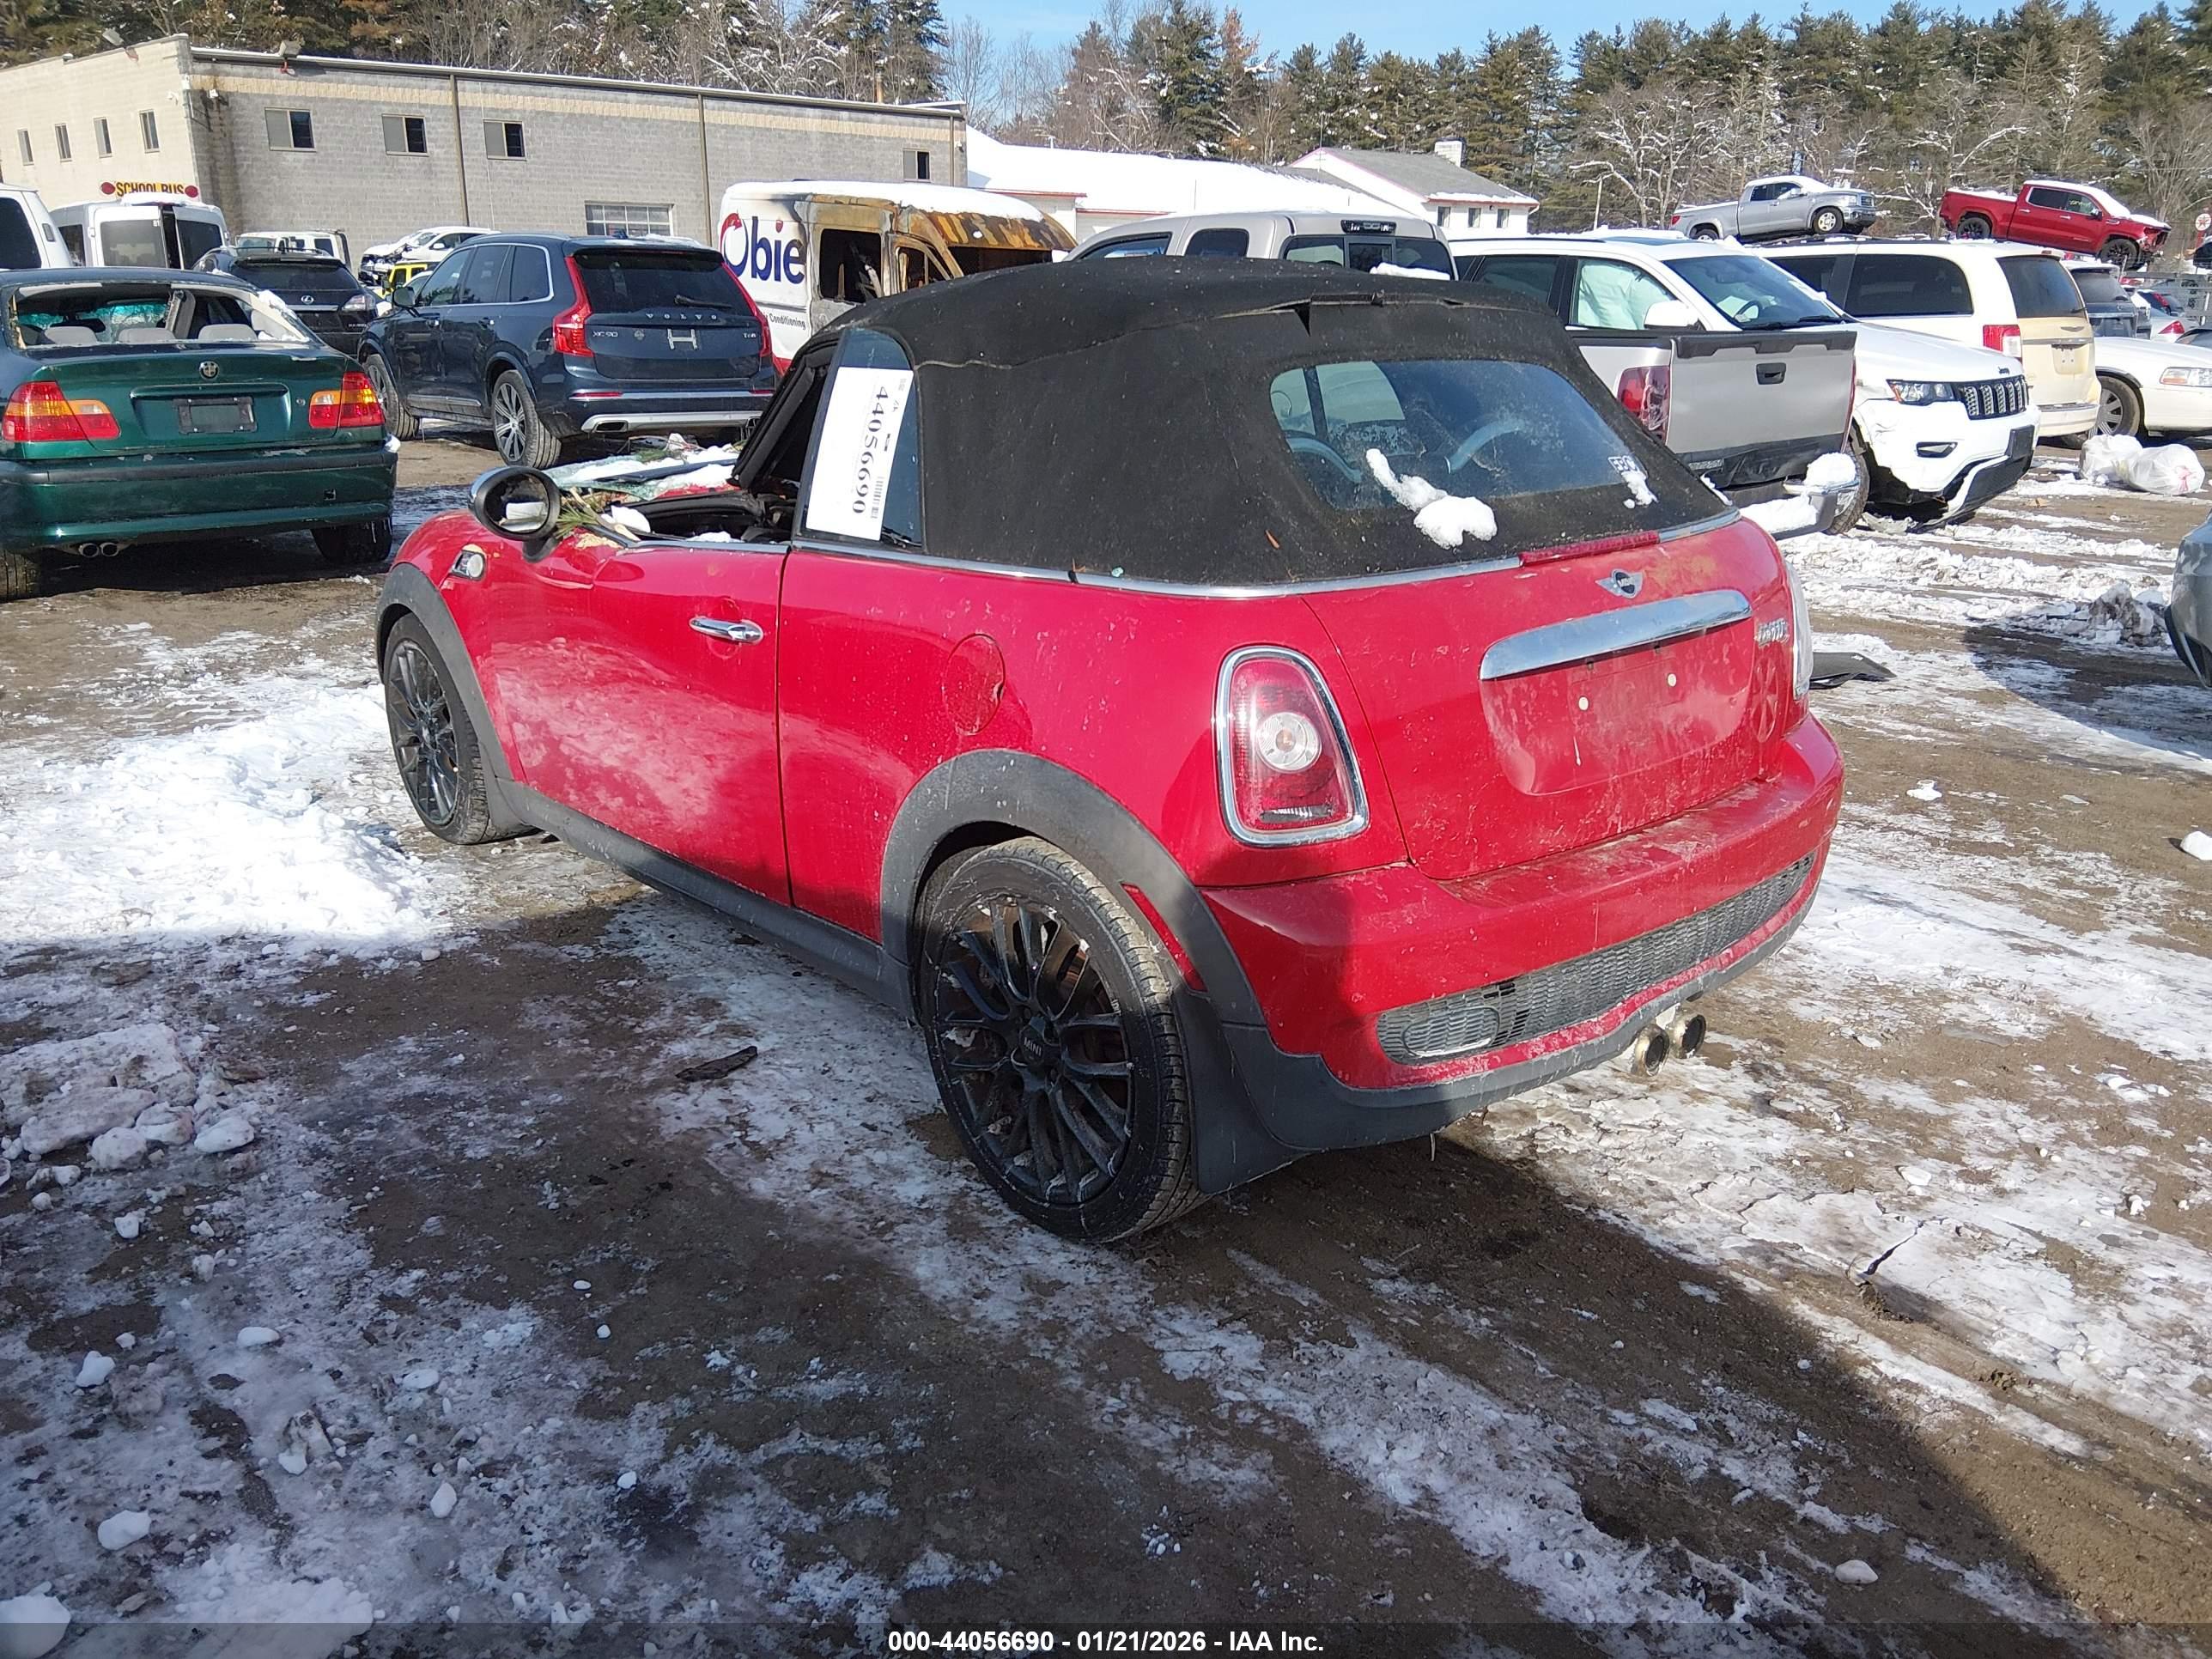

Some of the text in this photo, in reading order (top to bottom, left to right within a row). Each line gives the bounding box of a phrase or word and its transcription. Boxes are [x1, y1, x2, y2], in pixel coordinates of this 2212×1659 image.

[116, 181, 185, 197] SCHOOL BUS
[720, 212, 807, 285] Obie
[769, 313, 806, 331] Conditioning
[852, 386, 889, 514] 44056690
[1024, 1036, 1042, 1057] MINI
